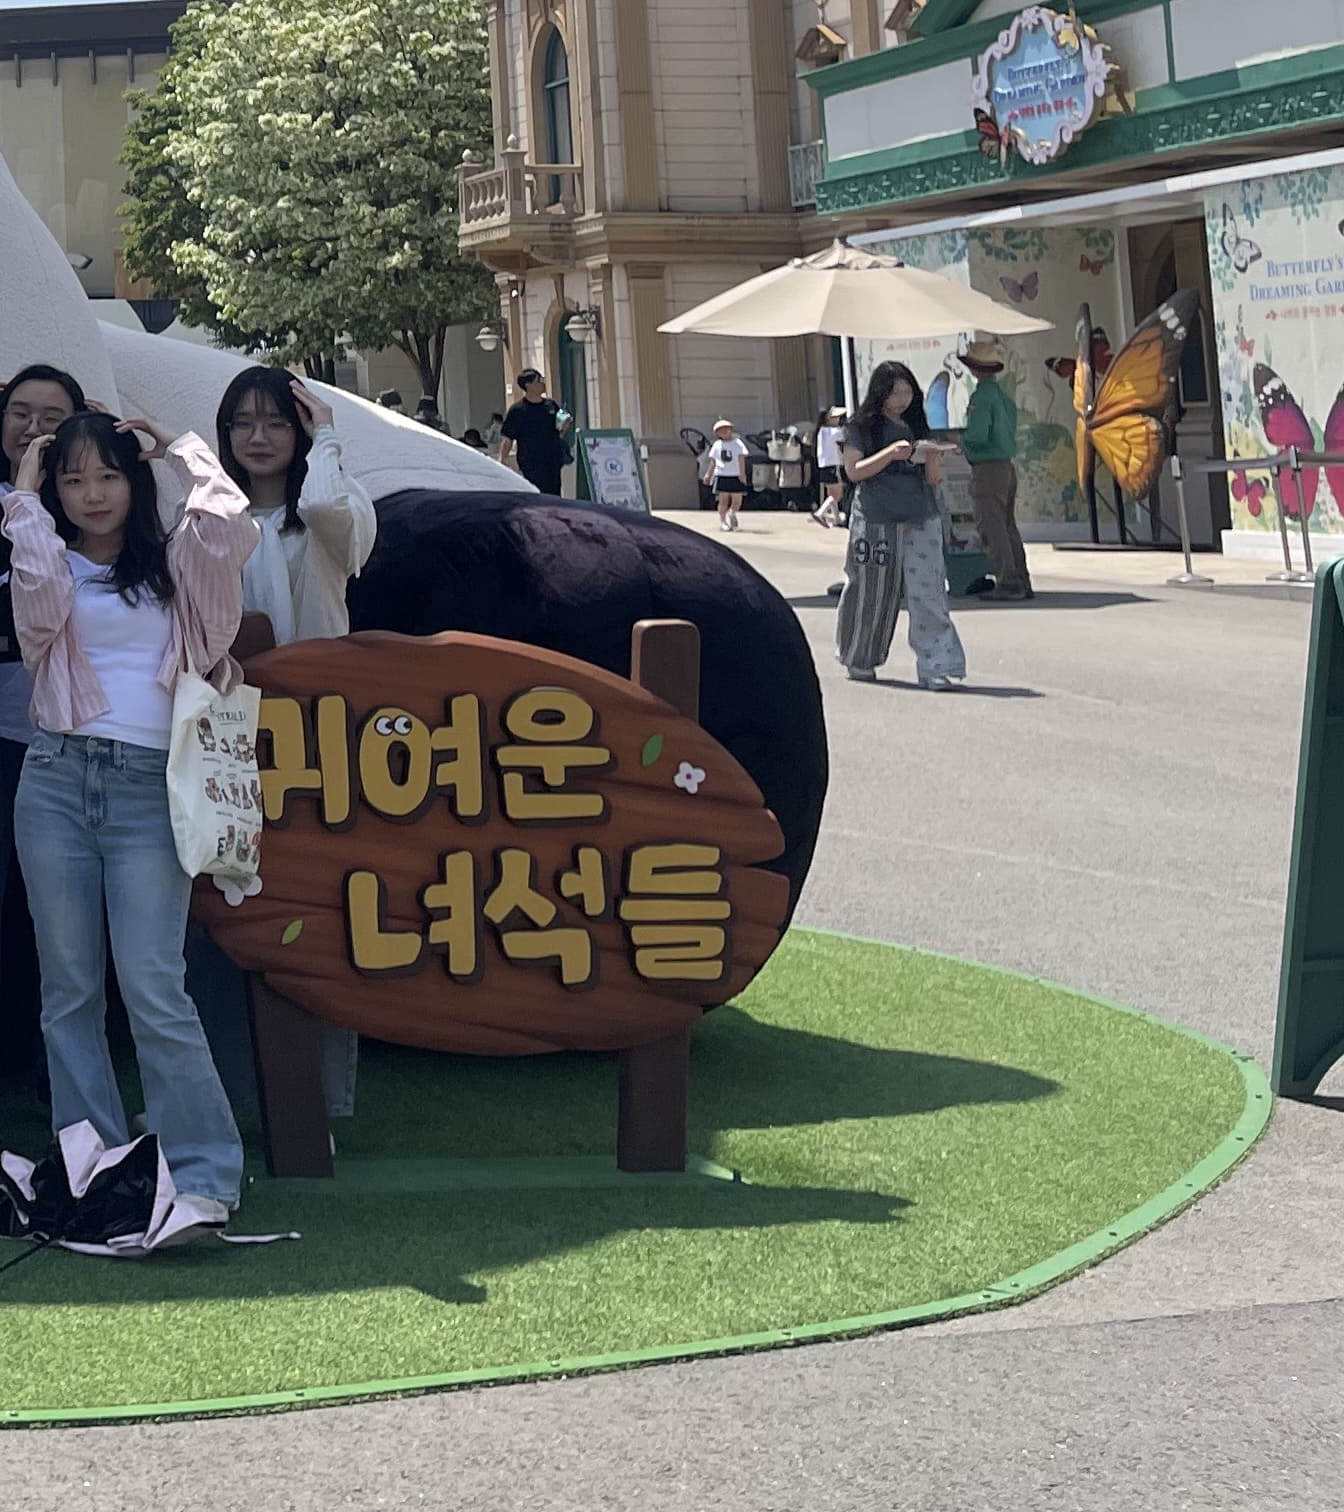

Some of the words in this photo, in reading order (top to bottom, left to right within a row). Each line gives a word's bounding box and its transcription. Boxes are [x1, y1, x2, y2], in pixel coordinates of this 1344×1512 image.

[1249, 283, 1312, 302] DREAMING
[1315, 278, 1344, 295] GAR
[853, 538, 890, 566] 96
[261, 686, 612, 825] 귀여운
[346, 842, 733, 986] 녀석들
